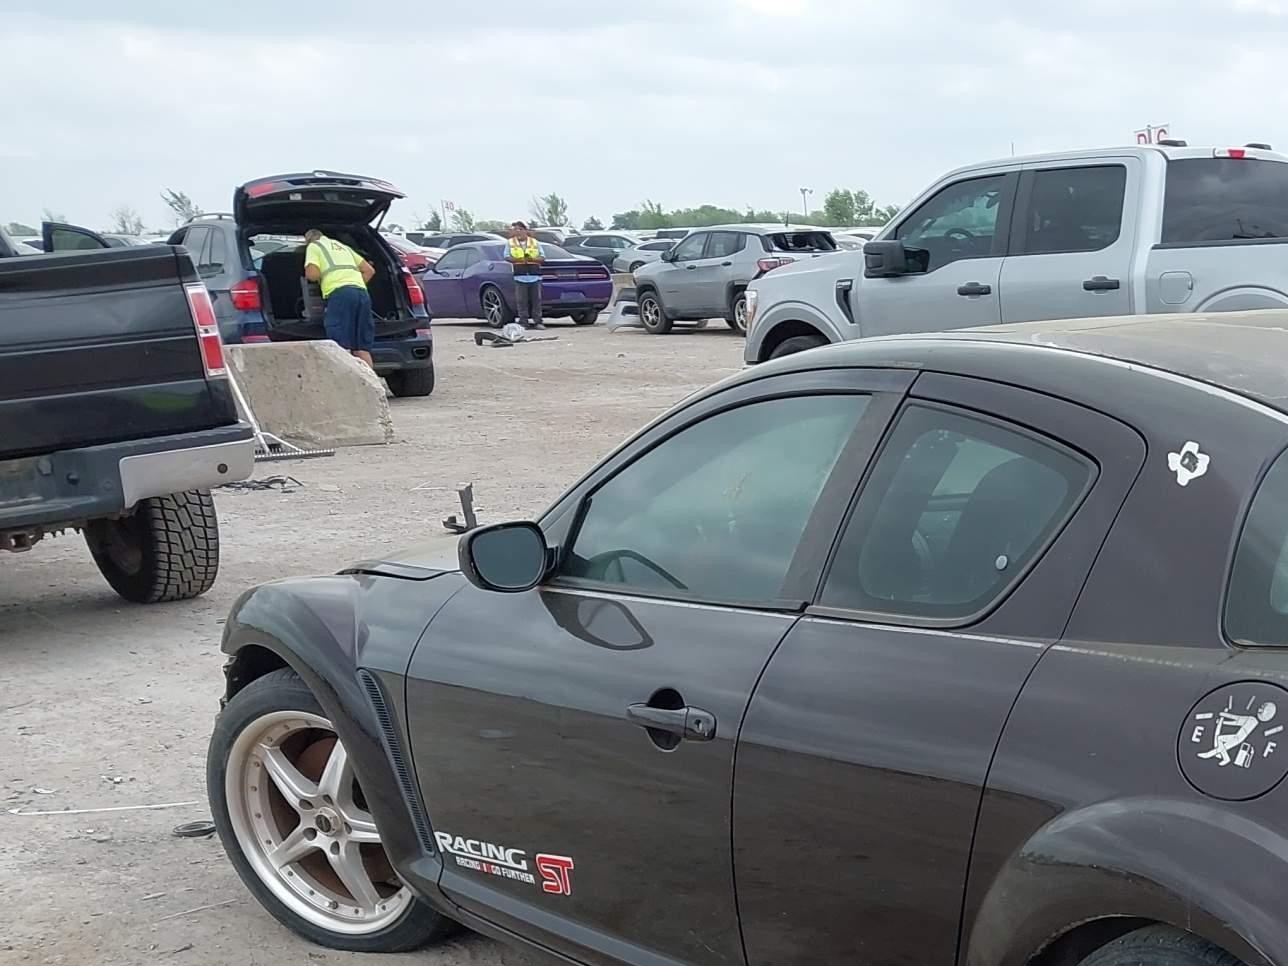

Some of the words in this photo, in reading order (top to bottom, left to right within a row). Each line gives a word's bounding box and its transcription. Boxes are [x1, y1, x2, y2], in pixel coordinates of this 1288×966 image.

[1191, 725, 1204, 743] E
[1263, 741, 1277, 758] F
[434, 831, 528, 871] RACING
[535, 853, 574, 896] ST
[502, 869, 535, 884] FURTHER
